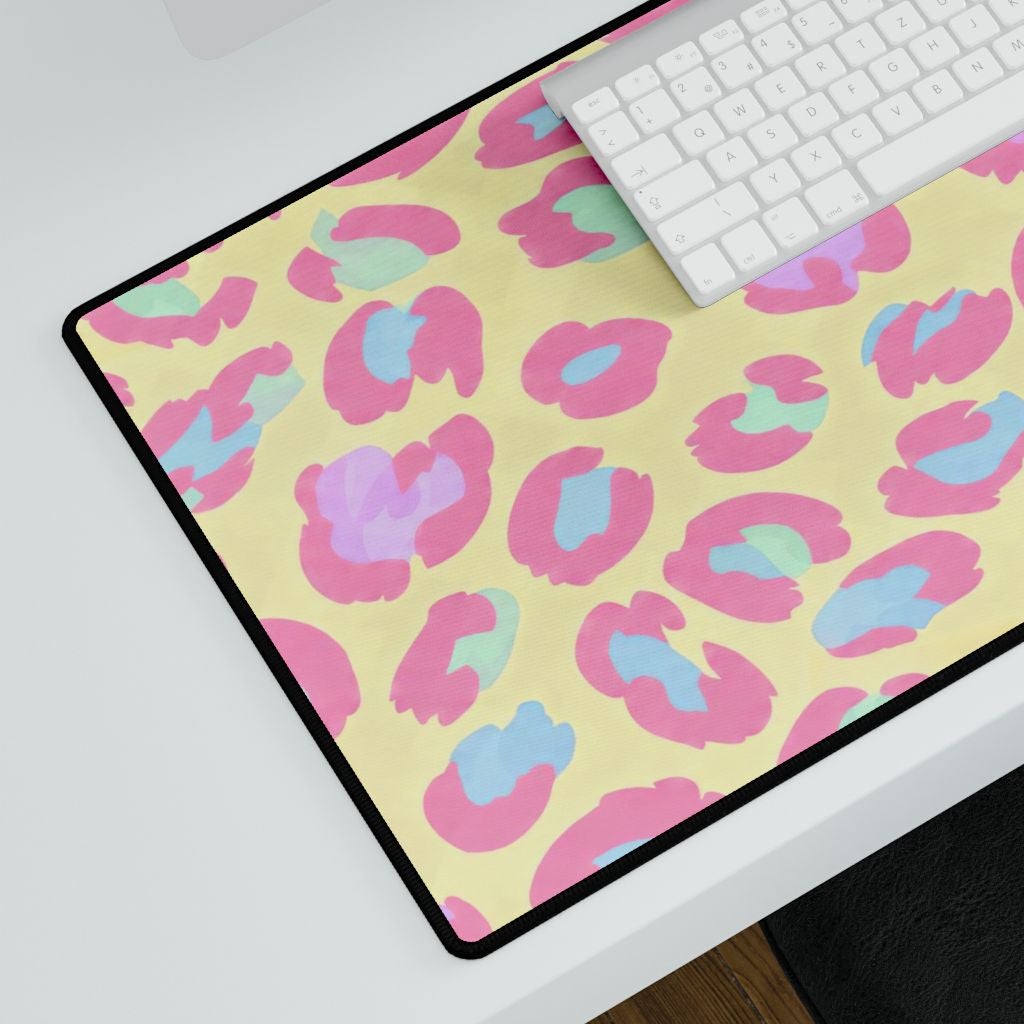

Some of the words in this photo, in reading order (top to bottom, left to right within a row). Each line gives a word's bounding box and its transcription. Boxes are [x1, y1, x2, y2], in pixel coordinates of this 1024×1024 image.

[677, 82, 688, 94] 2
[718, 60, 728, 72] 3
[759, 38, 769, 48] 4
[799, 15, 809, 27] 5
[693, 127, 707, 138] Q
[731, 103, 747, 117] W
[775, 82, 787, 95] E
[815, 61, 828, 73] R
[855, 38, 866, 50] T
[896, 17, 909, 29] Z
[726, 150, 737, 164] A
[765, 128, 777, 140] S
[805, 106, 818, 119] D
[847, 83, 857, 95] F
[887, 61, 899, 73] G
[926, 39, 939, 52] H
[969, 17, 978, 30] J
[768, 172, 779, 184] Y
[809, 149, 823, 163] X
[850, 127, 863, 139] C
[889, 105, 902, 117] V
[931, 82, 944, 96] B
[970, 60, 985, 73] N
[1010, 39, 1024, 52] M
[825, 205, 843, 219] cmd
